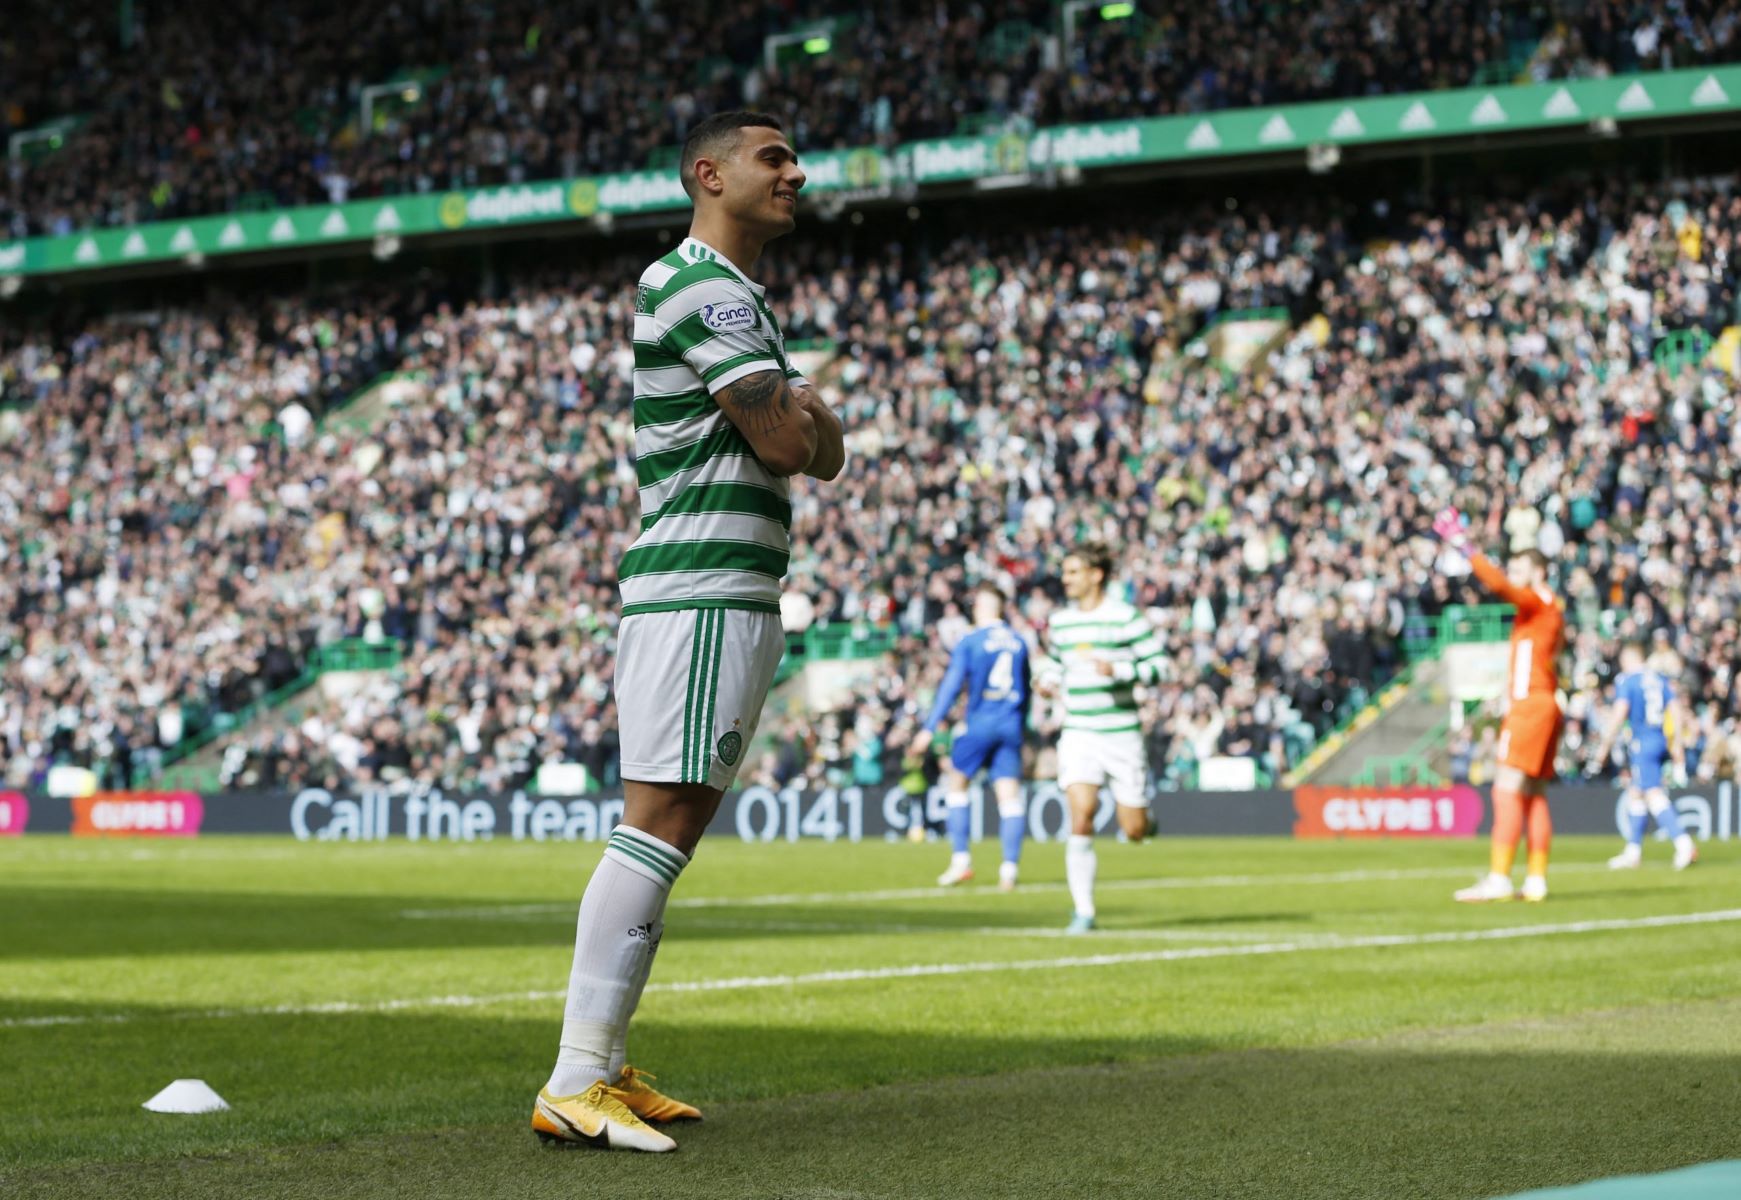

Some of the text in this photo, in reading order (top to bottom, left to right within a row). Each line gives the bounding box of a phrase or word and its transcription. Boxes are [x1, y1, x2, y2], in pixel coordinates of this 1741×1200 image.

[718, 307, 751, 321] cinch
[988, 650, 1013, 694] 4
[290, 787, 390, 841] Call
[403, 787, 496, 841] the
[735, 786, 864, 843] 0141
[1322, 797, 1454, 830] CLYDE 1
